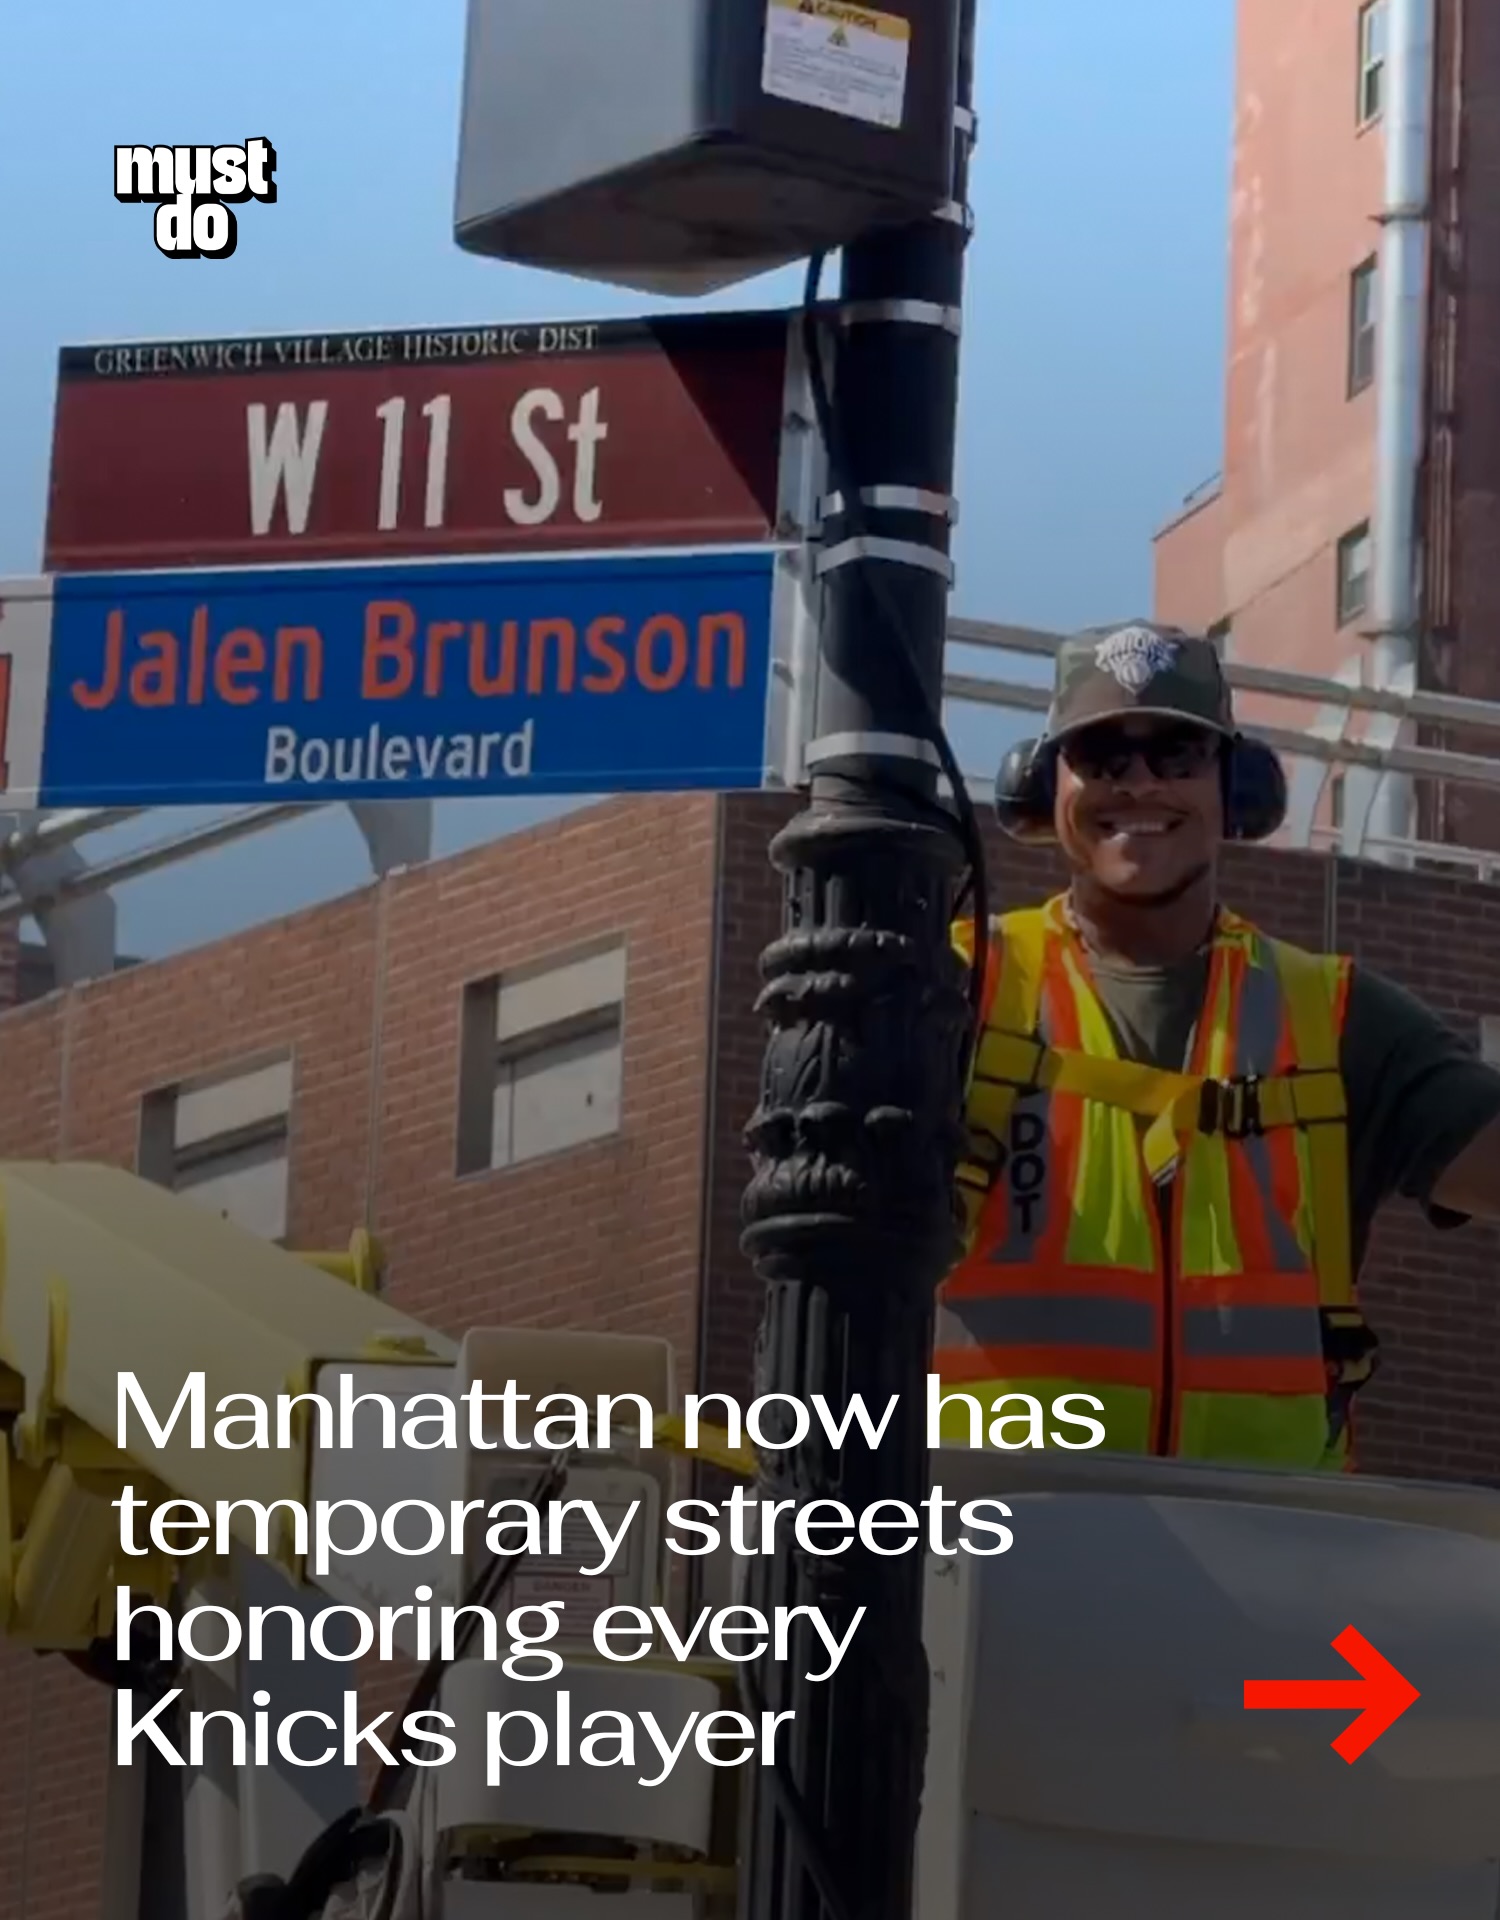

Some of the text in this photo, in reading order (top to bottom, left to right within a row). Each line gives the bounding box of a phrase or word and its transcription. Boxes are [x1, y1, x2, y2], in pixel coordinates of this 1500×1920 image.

[94, 325, 599, 375] GREENWICH VILLAGE HISTORIC DIST
[247, 386, 608, 535] W 11 St
[71, 604, 324, 710] Jalen
[360, 599, 746, 700] Brunson
[264, 718, 535, 784] Boulevard
[1011, 1113, 1045, 1233] DOT
